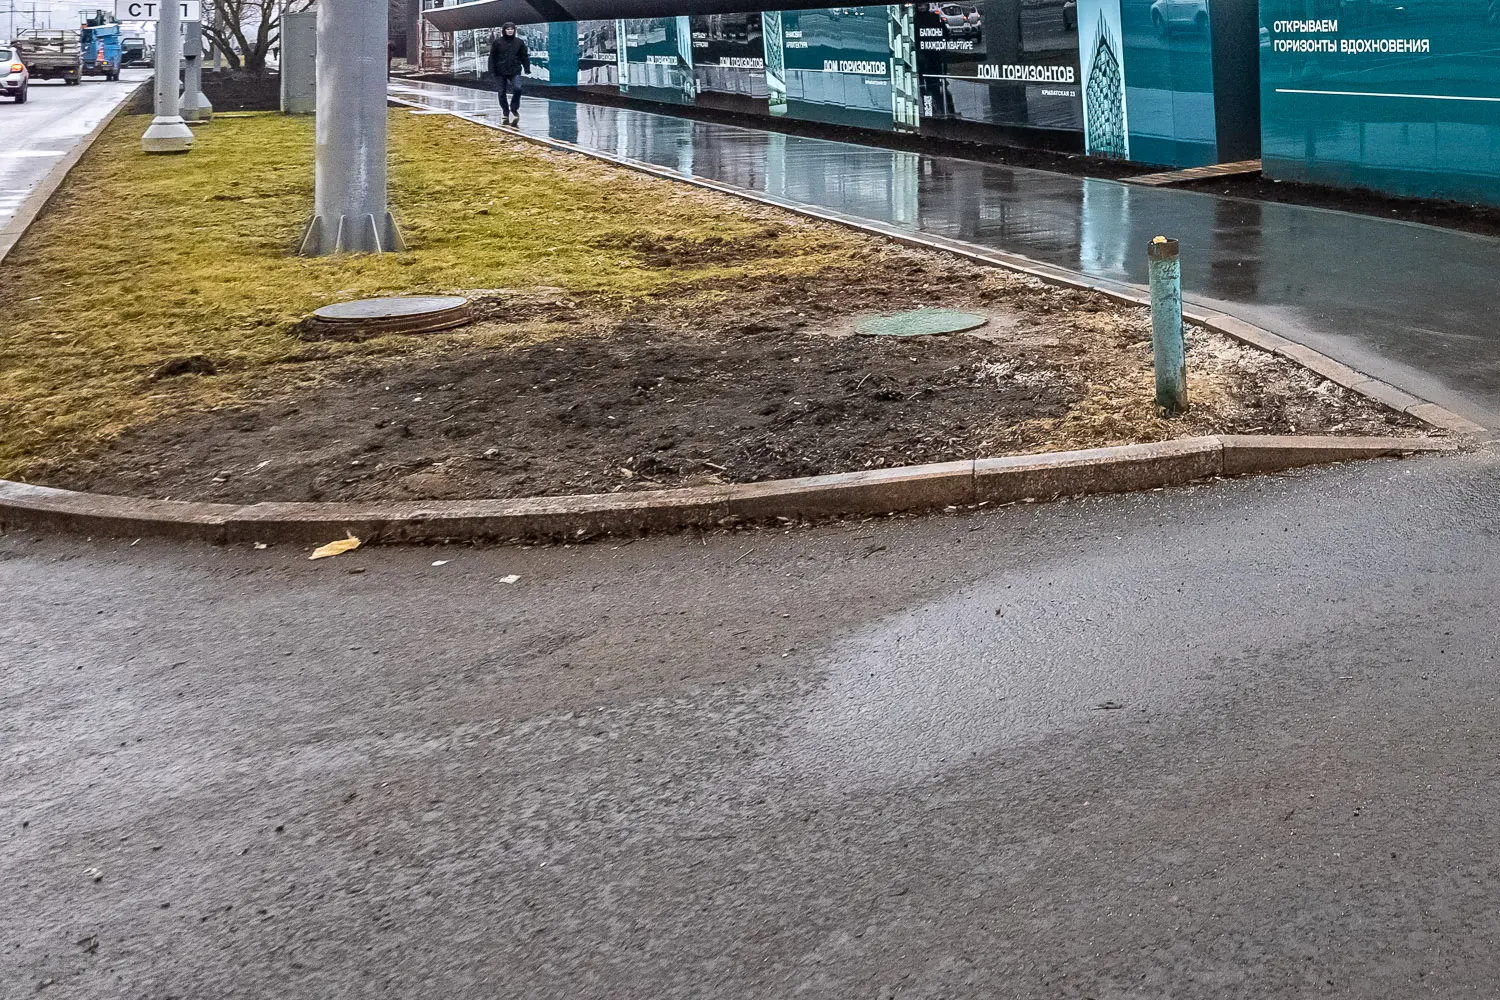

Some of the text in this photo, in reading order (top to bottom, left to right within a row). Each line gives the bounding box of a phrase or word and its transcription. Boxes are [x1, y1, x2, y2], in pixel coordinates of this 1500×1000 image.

[128, 3, 188, 18] СТП
[919, 27, 943, 37] БАЛКОНЫ
[1273, 19, 1338, 33] ОТКРЫВАЕМ
[924, 38, 947, 51] КАЖДОЙ
[947, 41, 973, 50] КВАРТИРЕ
[1273, 39, 1430, 55] ГОРИЗОНТЫ ВДОХНОВЕНИЯ
[823, 60, 887, 75] ДОМ ГОРИЗОНТОВ
[977, 64, 1075, 83] ДОМ ГОРИЗОНТОВ
